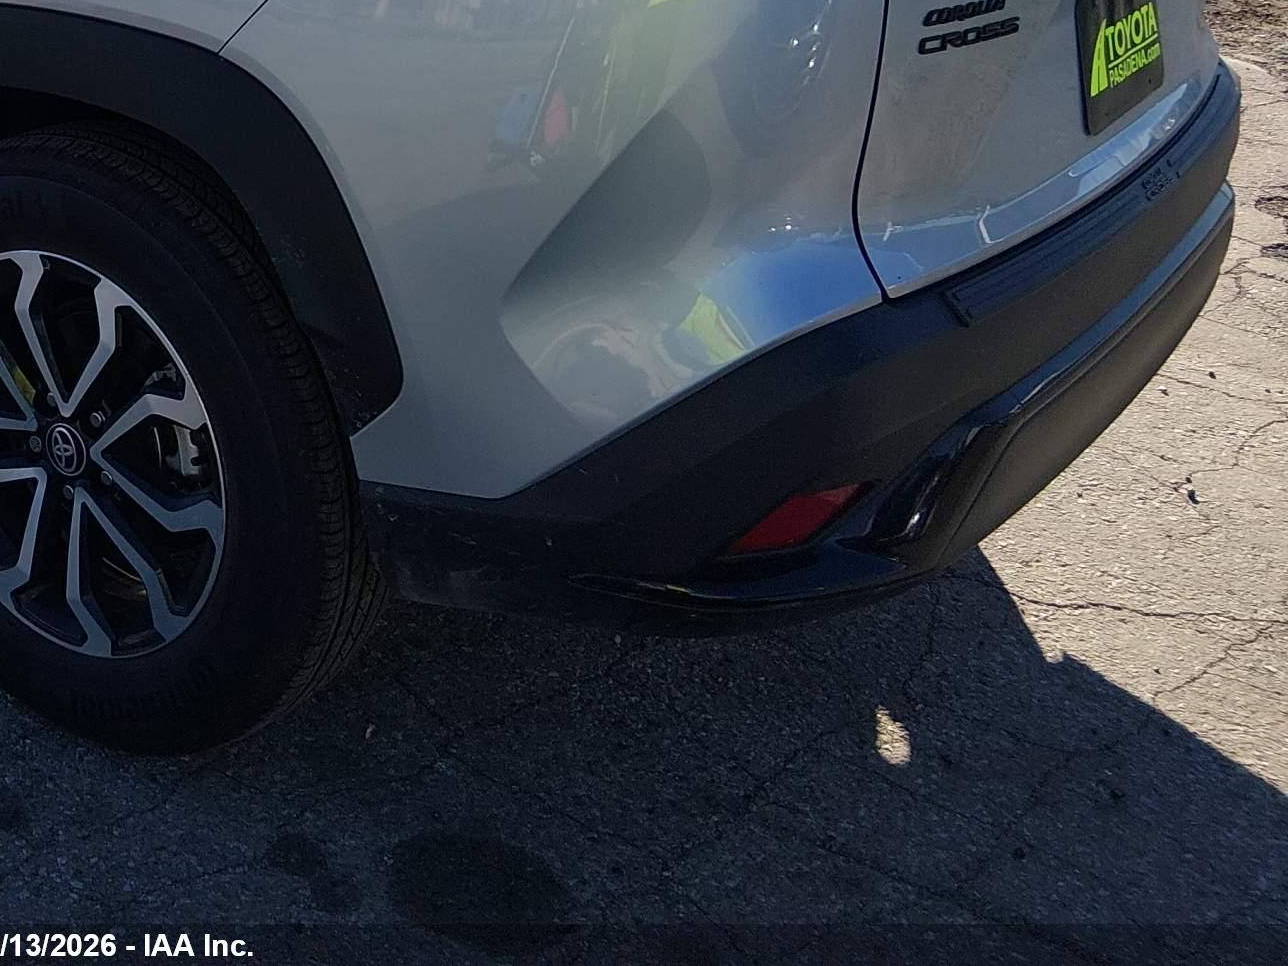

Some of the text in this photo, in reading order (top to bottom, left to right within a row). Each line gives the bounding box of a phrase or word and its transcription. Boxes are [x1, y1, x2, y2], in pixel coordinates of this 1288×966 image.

[918, 16, 1020, 54] CROSS
[1105, 2, 1158, 61] TOYOTA
[1109, 42, 1161, 88] PASADENA.com
